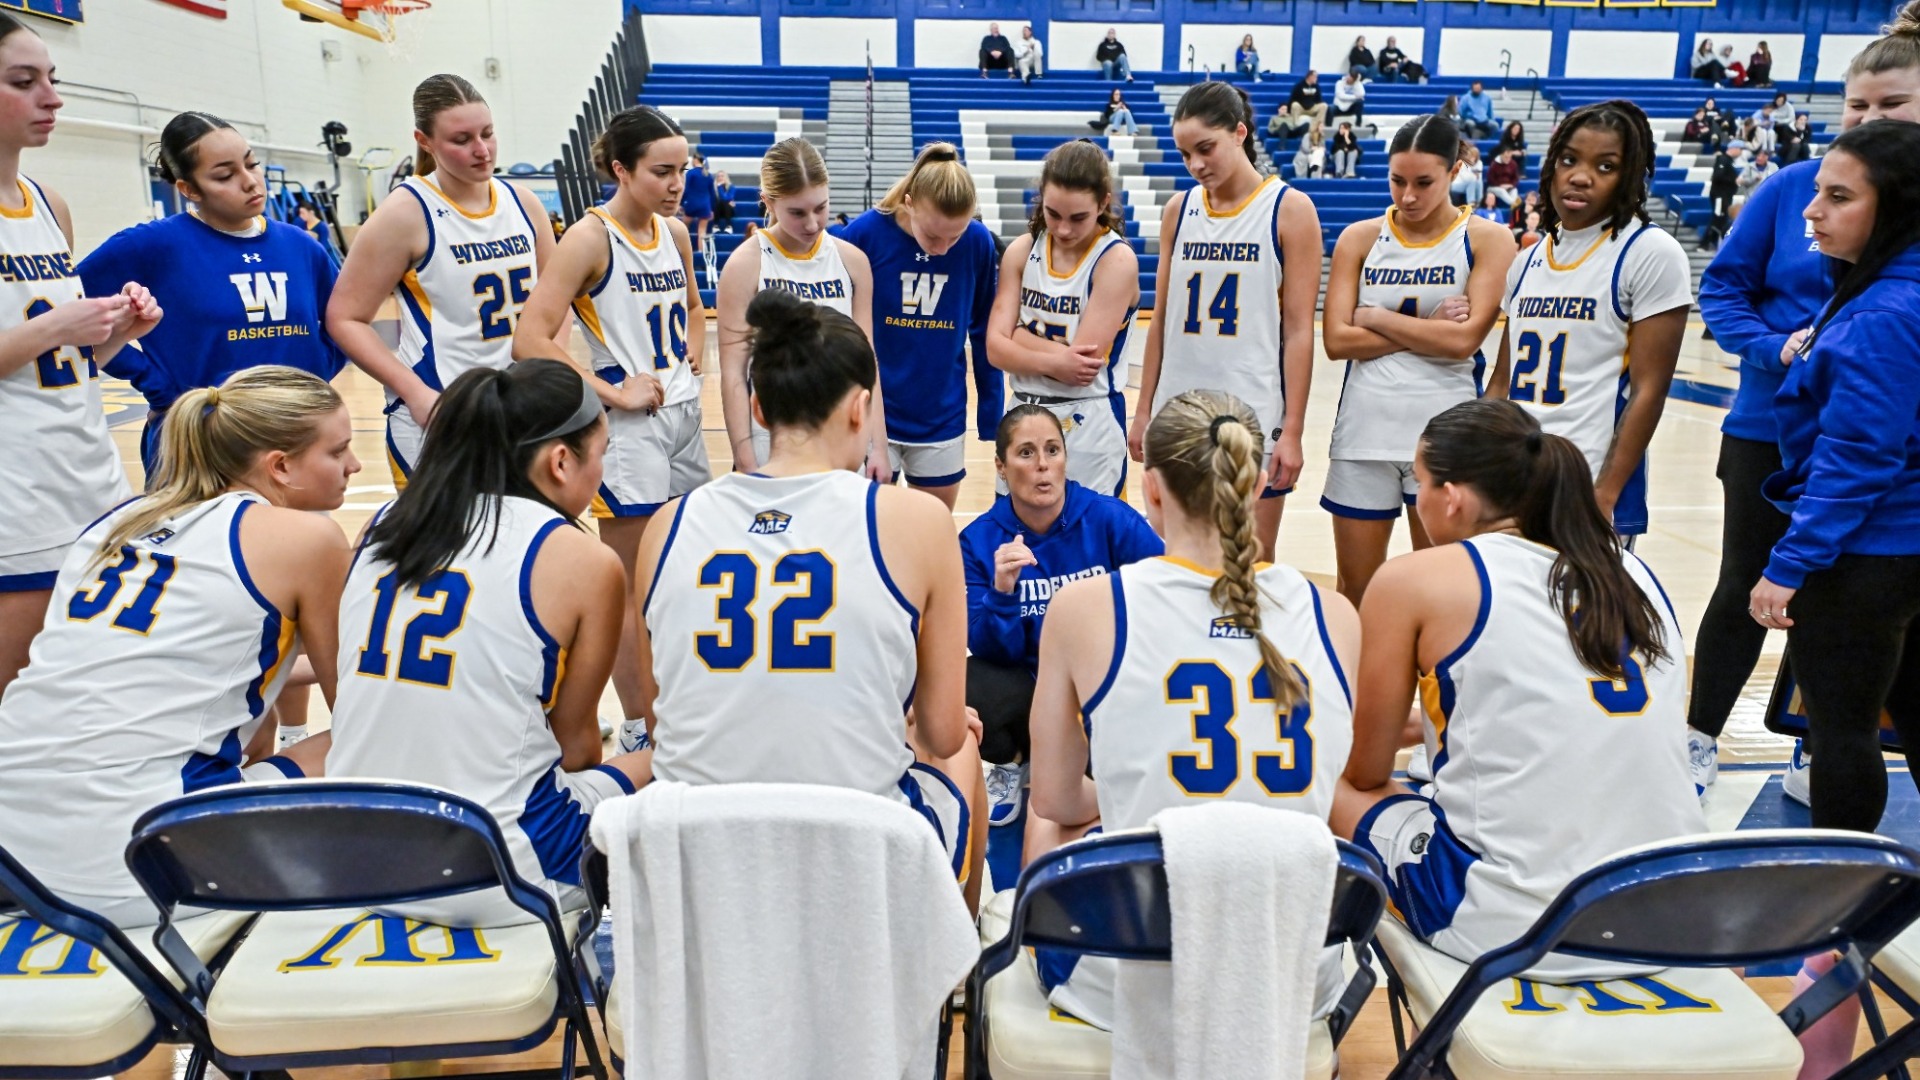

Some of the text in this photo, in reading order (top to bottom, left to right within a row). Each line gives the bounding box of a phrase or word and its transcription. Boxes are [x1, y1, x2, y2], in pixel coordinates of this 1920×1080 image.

[0, 251, 78, 283] WIDENE
[449, 233, 532, 265] WIDENER
[1182, 241, 1261, 263] WIDENER
[229, 272, 289, 323] W
[900, 272, 949, 316] W
[1364, 265, 1456, 286] WIDENER
[472, 264, 533, 342] 25
[885, 316, 955, 329] BASKETBALL
[1183, 271, 1241, 337] 14
[1517, 296, 1598, 321] WIDENER
[227, 324, 310, 341] BASKETBALL
[645, 301, 688, 371] 10
[1510, 329, 1569, 407] 21
[751, 519, 788, 534] MAC
[66, 545, 178, 637] 31
[693, 548, 838, 673] 32
[355, 565, 474, 690] 12
[1163, 658, 1317, 798] 33
